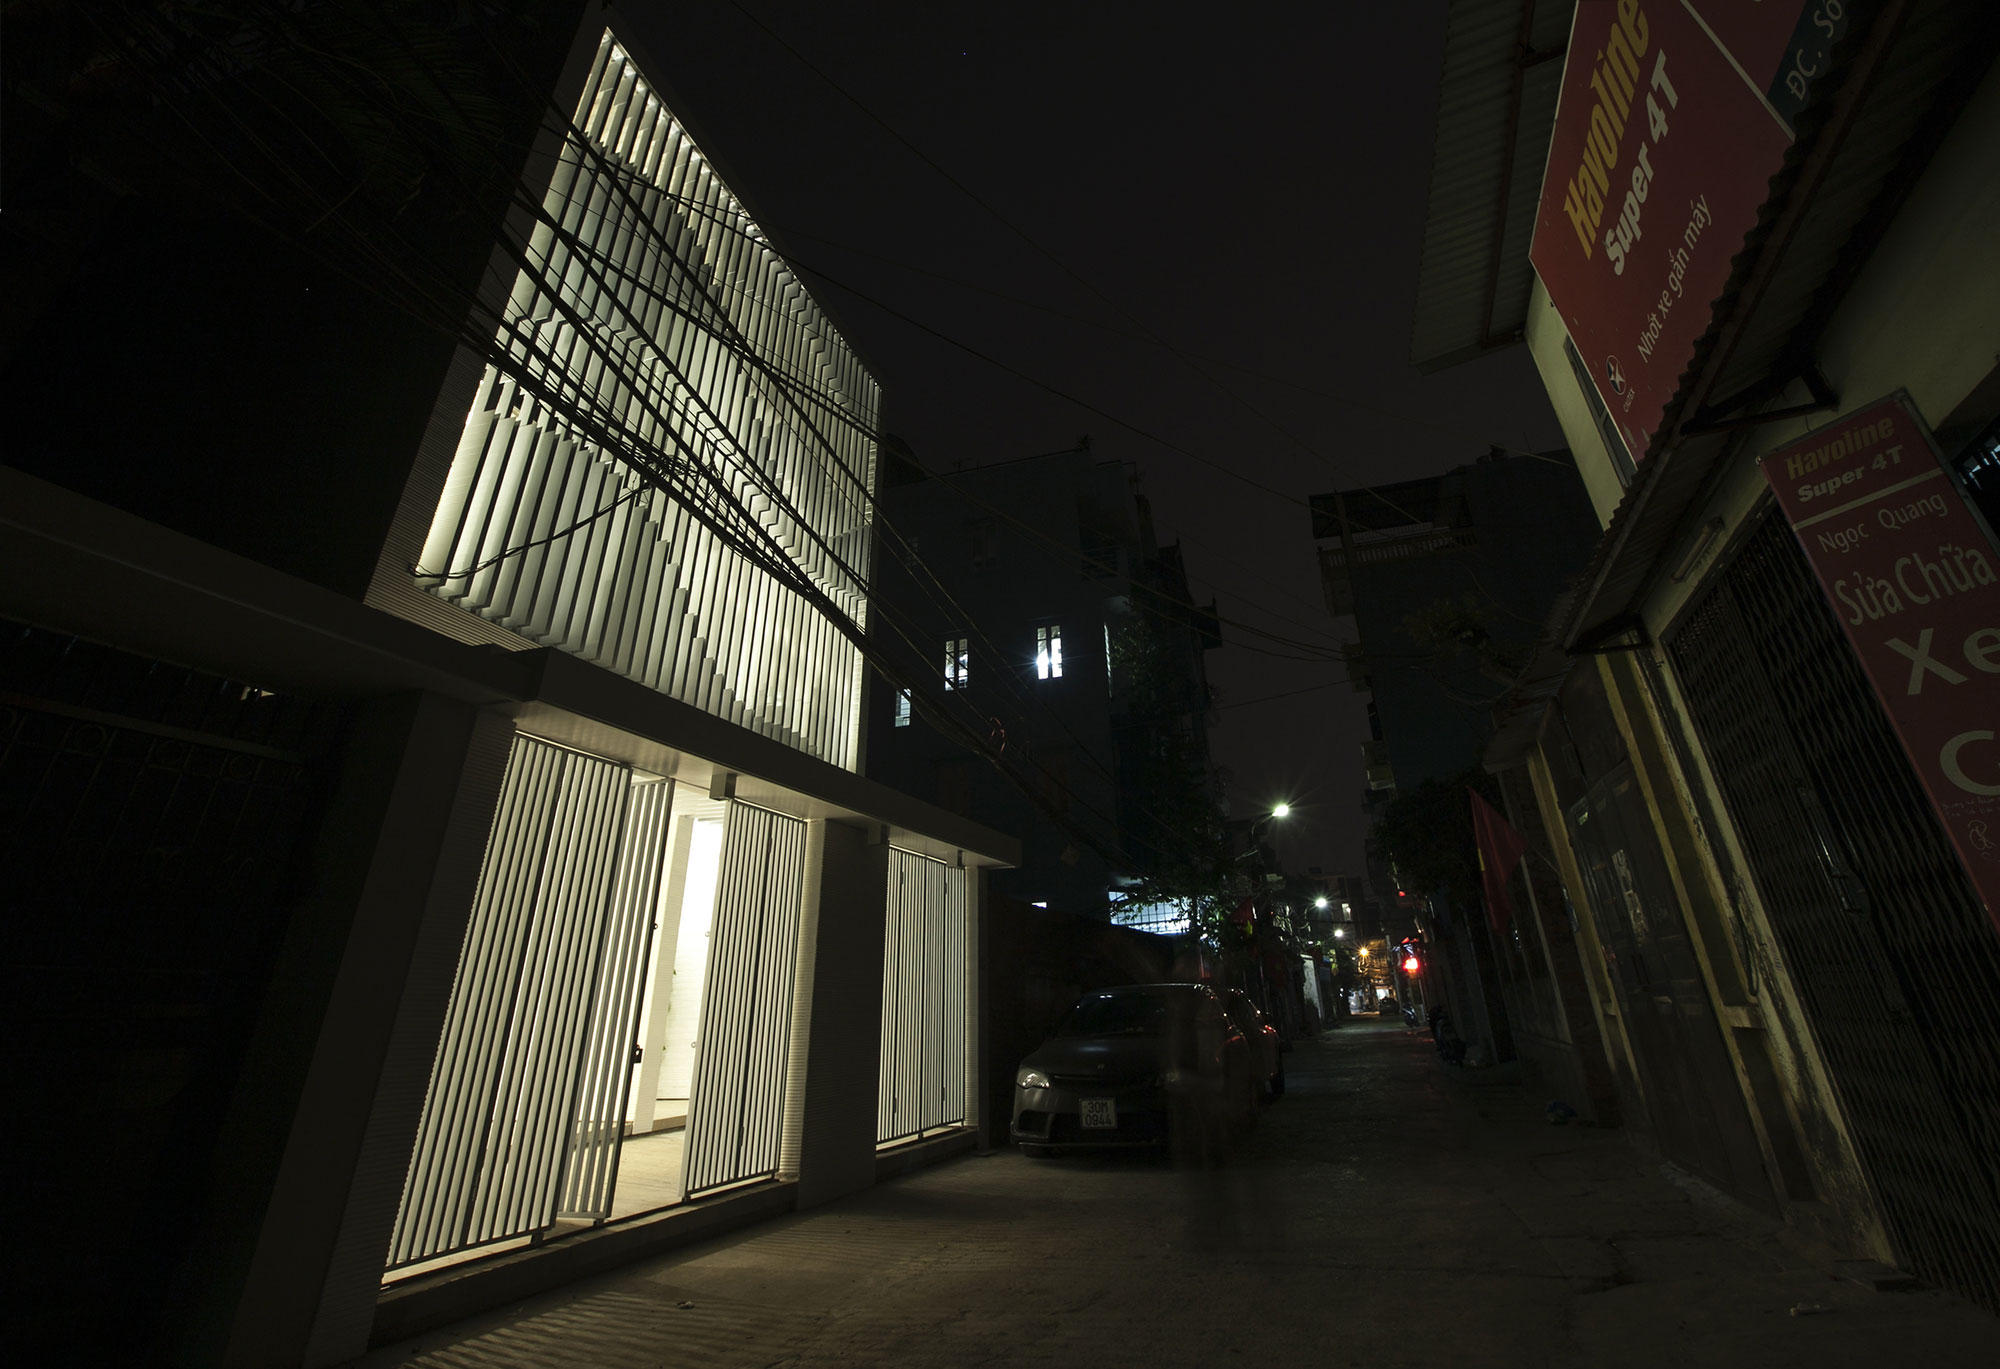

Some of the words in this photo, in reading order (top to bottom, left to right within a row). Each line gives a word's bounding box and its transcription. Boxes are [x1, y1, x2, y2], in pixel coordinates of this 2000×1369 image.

[1563, 0, 1648, 261] Havoline
[1605, 140, 1654, 276] Super
[1646, 48, 1679, 145] 4T
[1657, 289, 1673, 320] xe
[1668, 248, 1690, 298] gắn
[1684, 194, 1712, 250] máy
[1784, 417, 1896, 481] Havoline
[1798, 466, 1865, 503] Super
[1871, 444, 1904, 471] 4T
[1816, 523, 1870, 553] Ngọc
[1877, 493, 1949, 530] Quang
[1834, 571, 1905, 626] Sửa
[1894, 543, 1999, 605] Chữa
[1883, 627, 2000, 696] Xe
[1086, 1113, 1112, 1126] 0944
[1087, 1101, 1109, 1113] 30M
